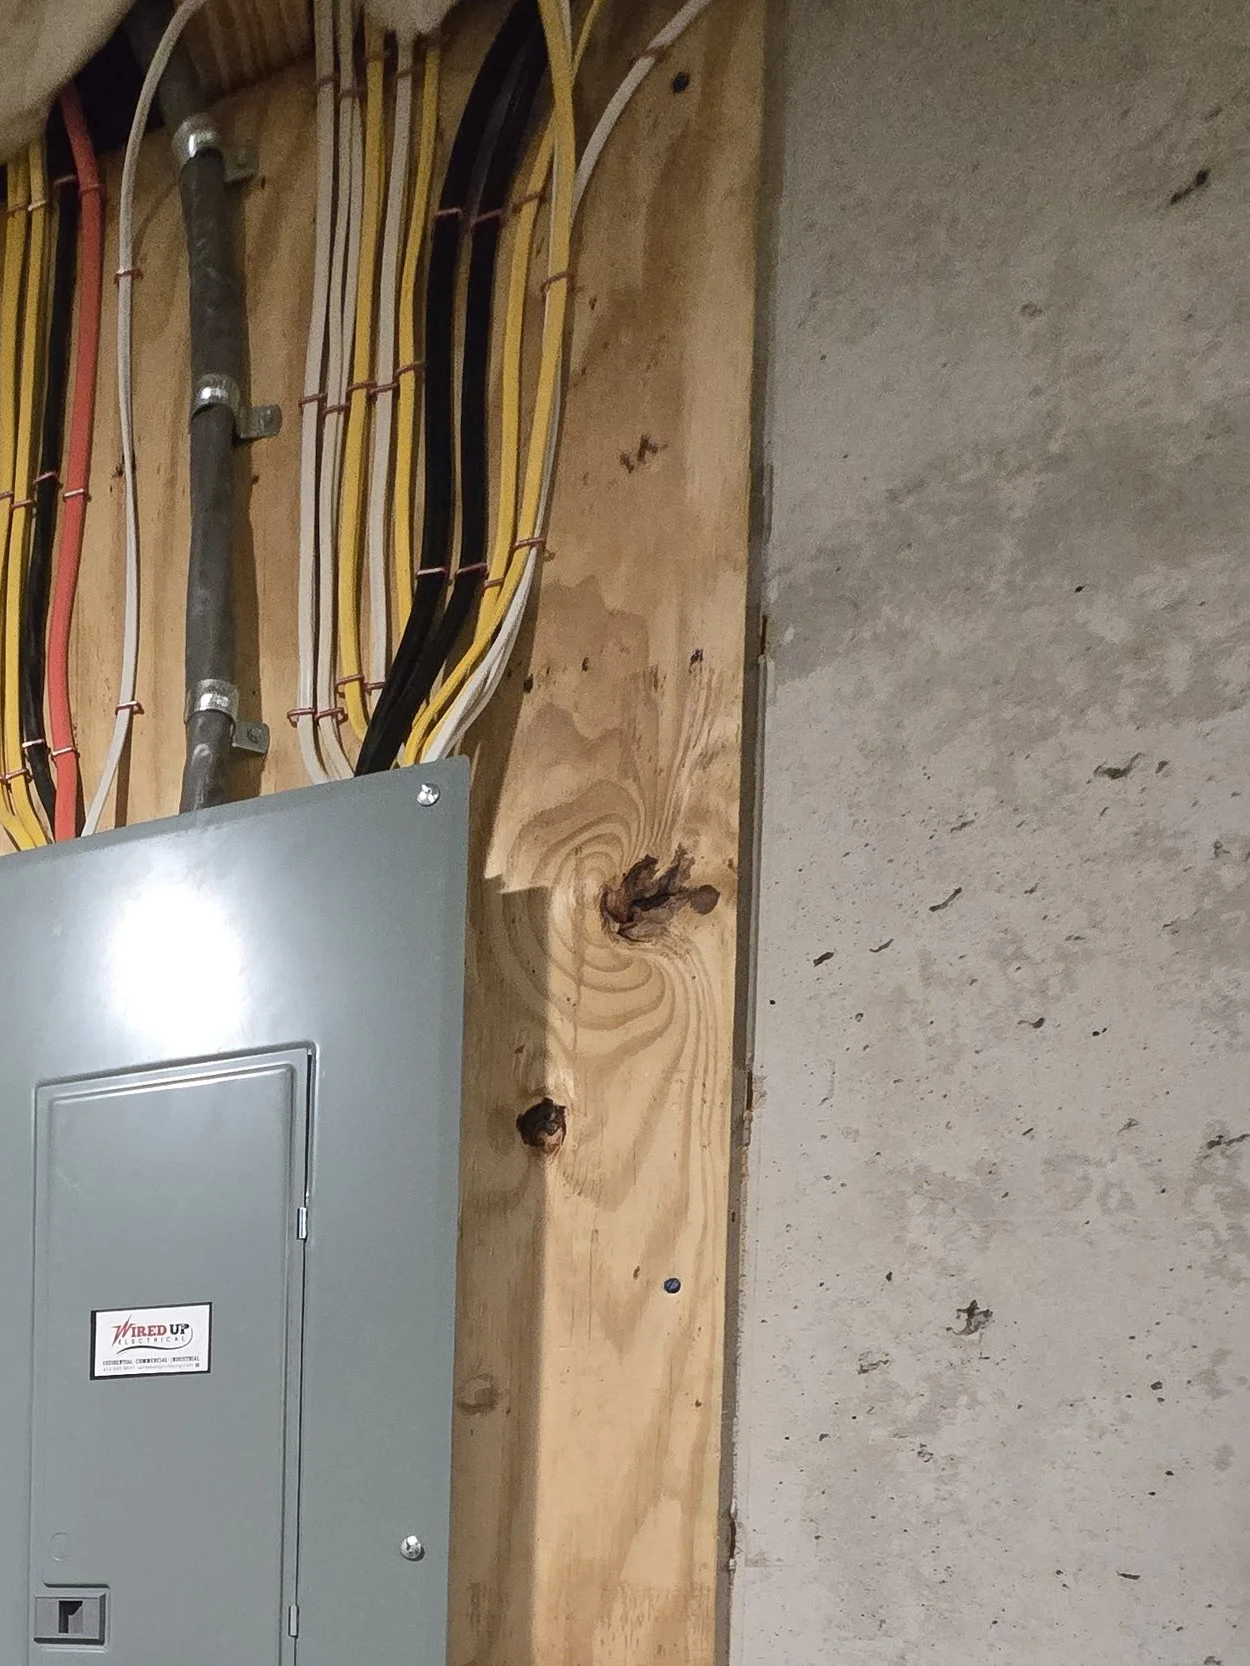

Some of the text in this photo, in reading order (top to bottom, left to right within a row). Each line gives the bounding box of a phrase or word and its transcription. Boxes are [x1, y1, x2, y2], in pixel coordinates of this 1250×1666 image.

[111, 1314, 190, 1347] WIRED UP
[118, 1336, 186, 1346] ELECTRICAL
